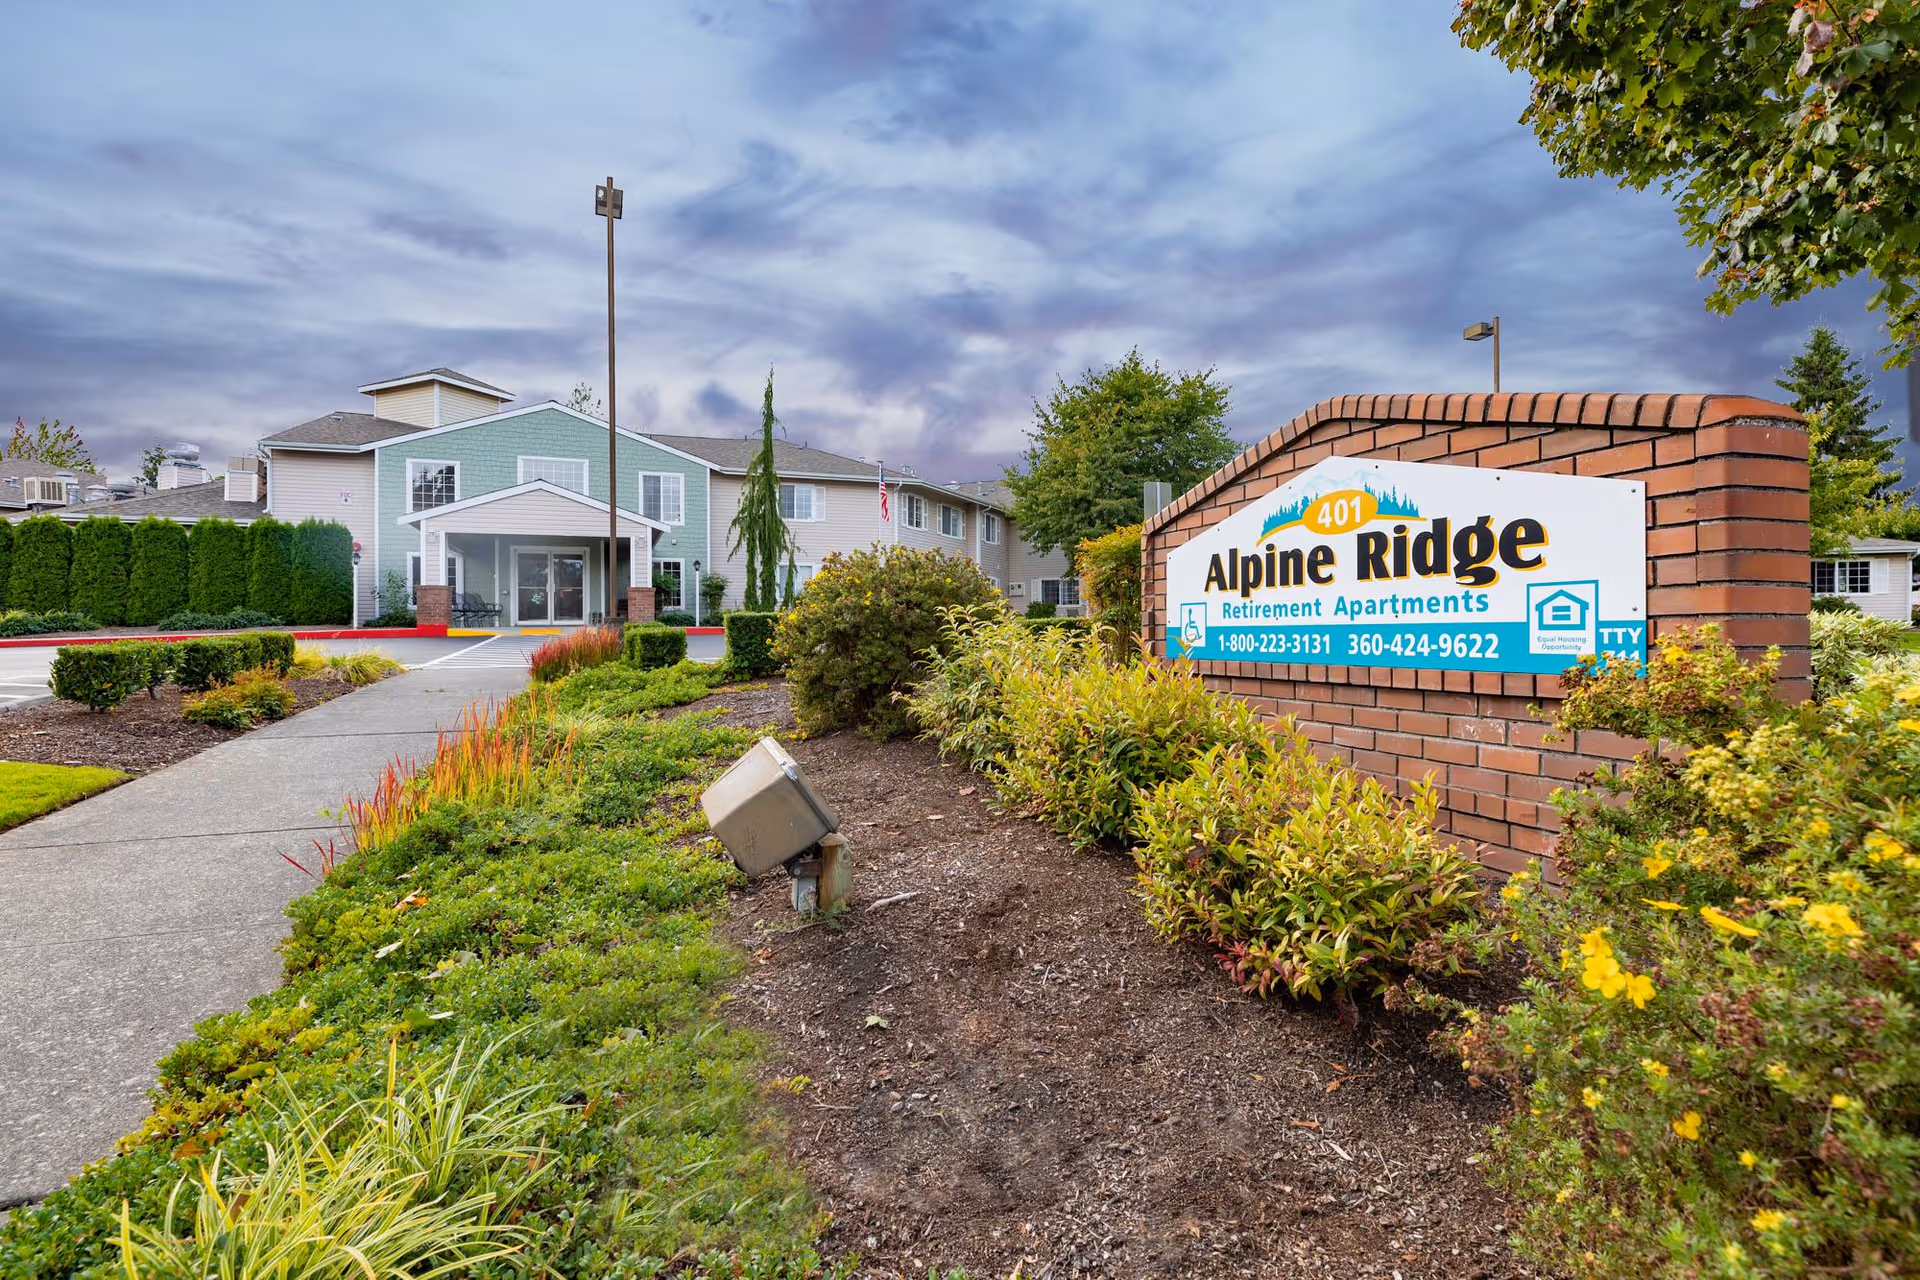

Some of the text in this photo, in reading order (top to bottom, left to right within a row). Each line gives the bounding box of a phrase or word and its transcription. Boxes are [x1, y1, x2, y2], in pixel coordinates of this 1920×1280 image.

[1317, 496, 1362, 528] 401
[1204, 515, 1549, 599] Alpine Ridge
[1222, 590, 1489, 621] Retirement Apartments
[1218, 633, 1499, 659] 1-800-223-3131 360-424-9622
[1541, 643, 1582, 651] Opportunity
[1599, 627, 1643, 644] TTY
